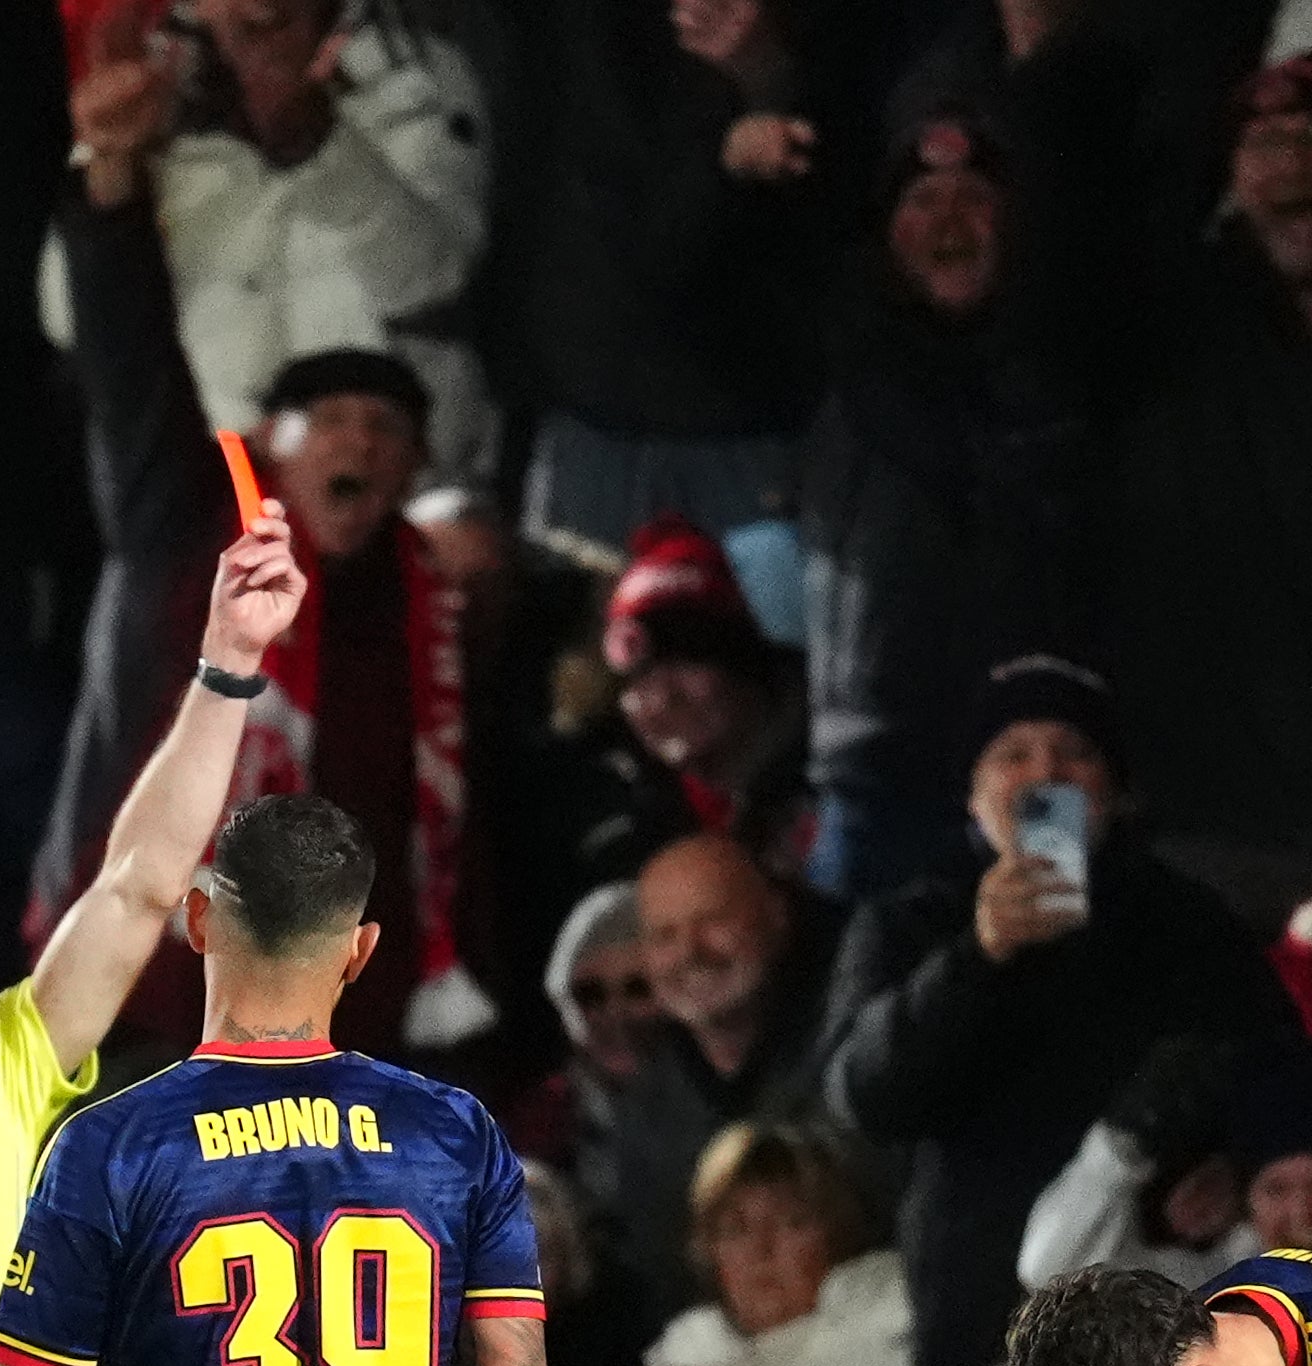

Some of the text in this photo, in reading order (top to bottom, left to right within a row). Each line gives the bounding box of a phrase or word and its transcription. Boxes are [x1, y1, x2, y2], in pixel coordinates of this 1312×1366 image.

[193, 1096, 393, 1162] BRUNO G.
[2, 1249, 35, 1296] el.
